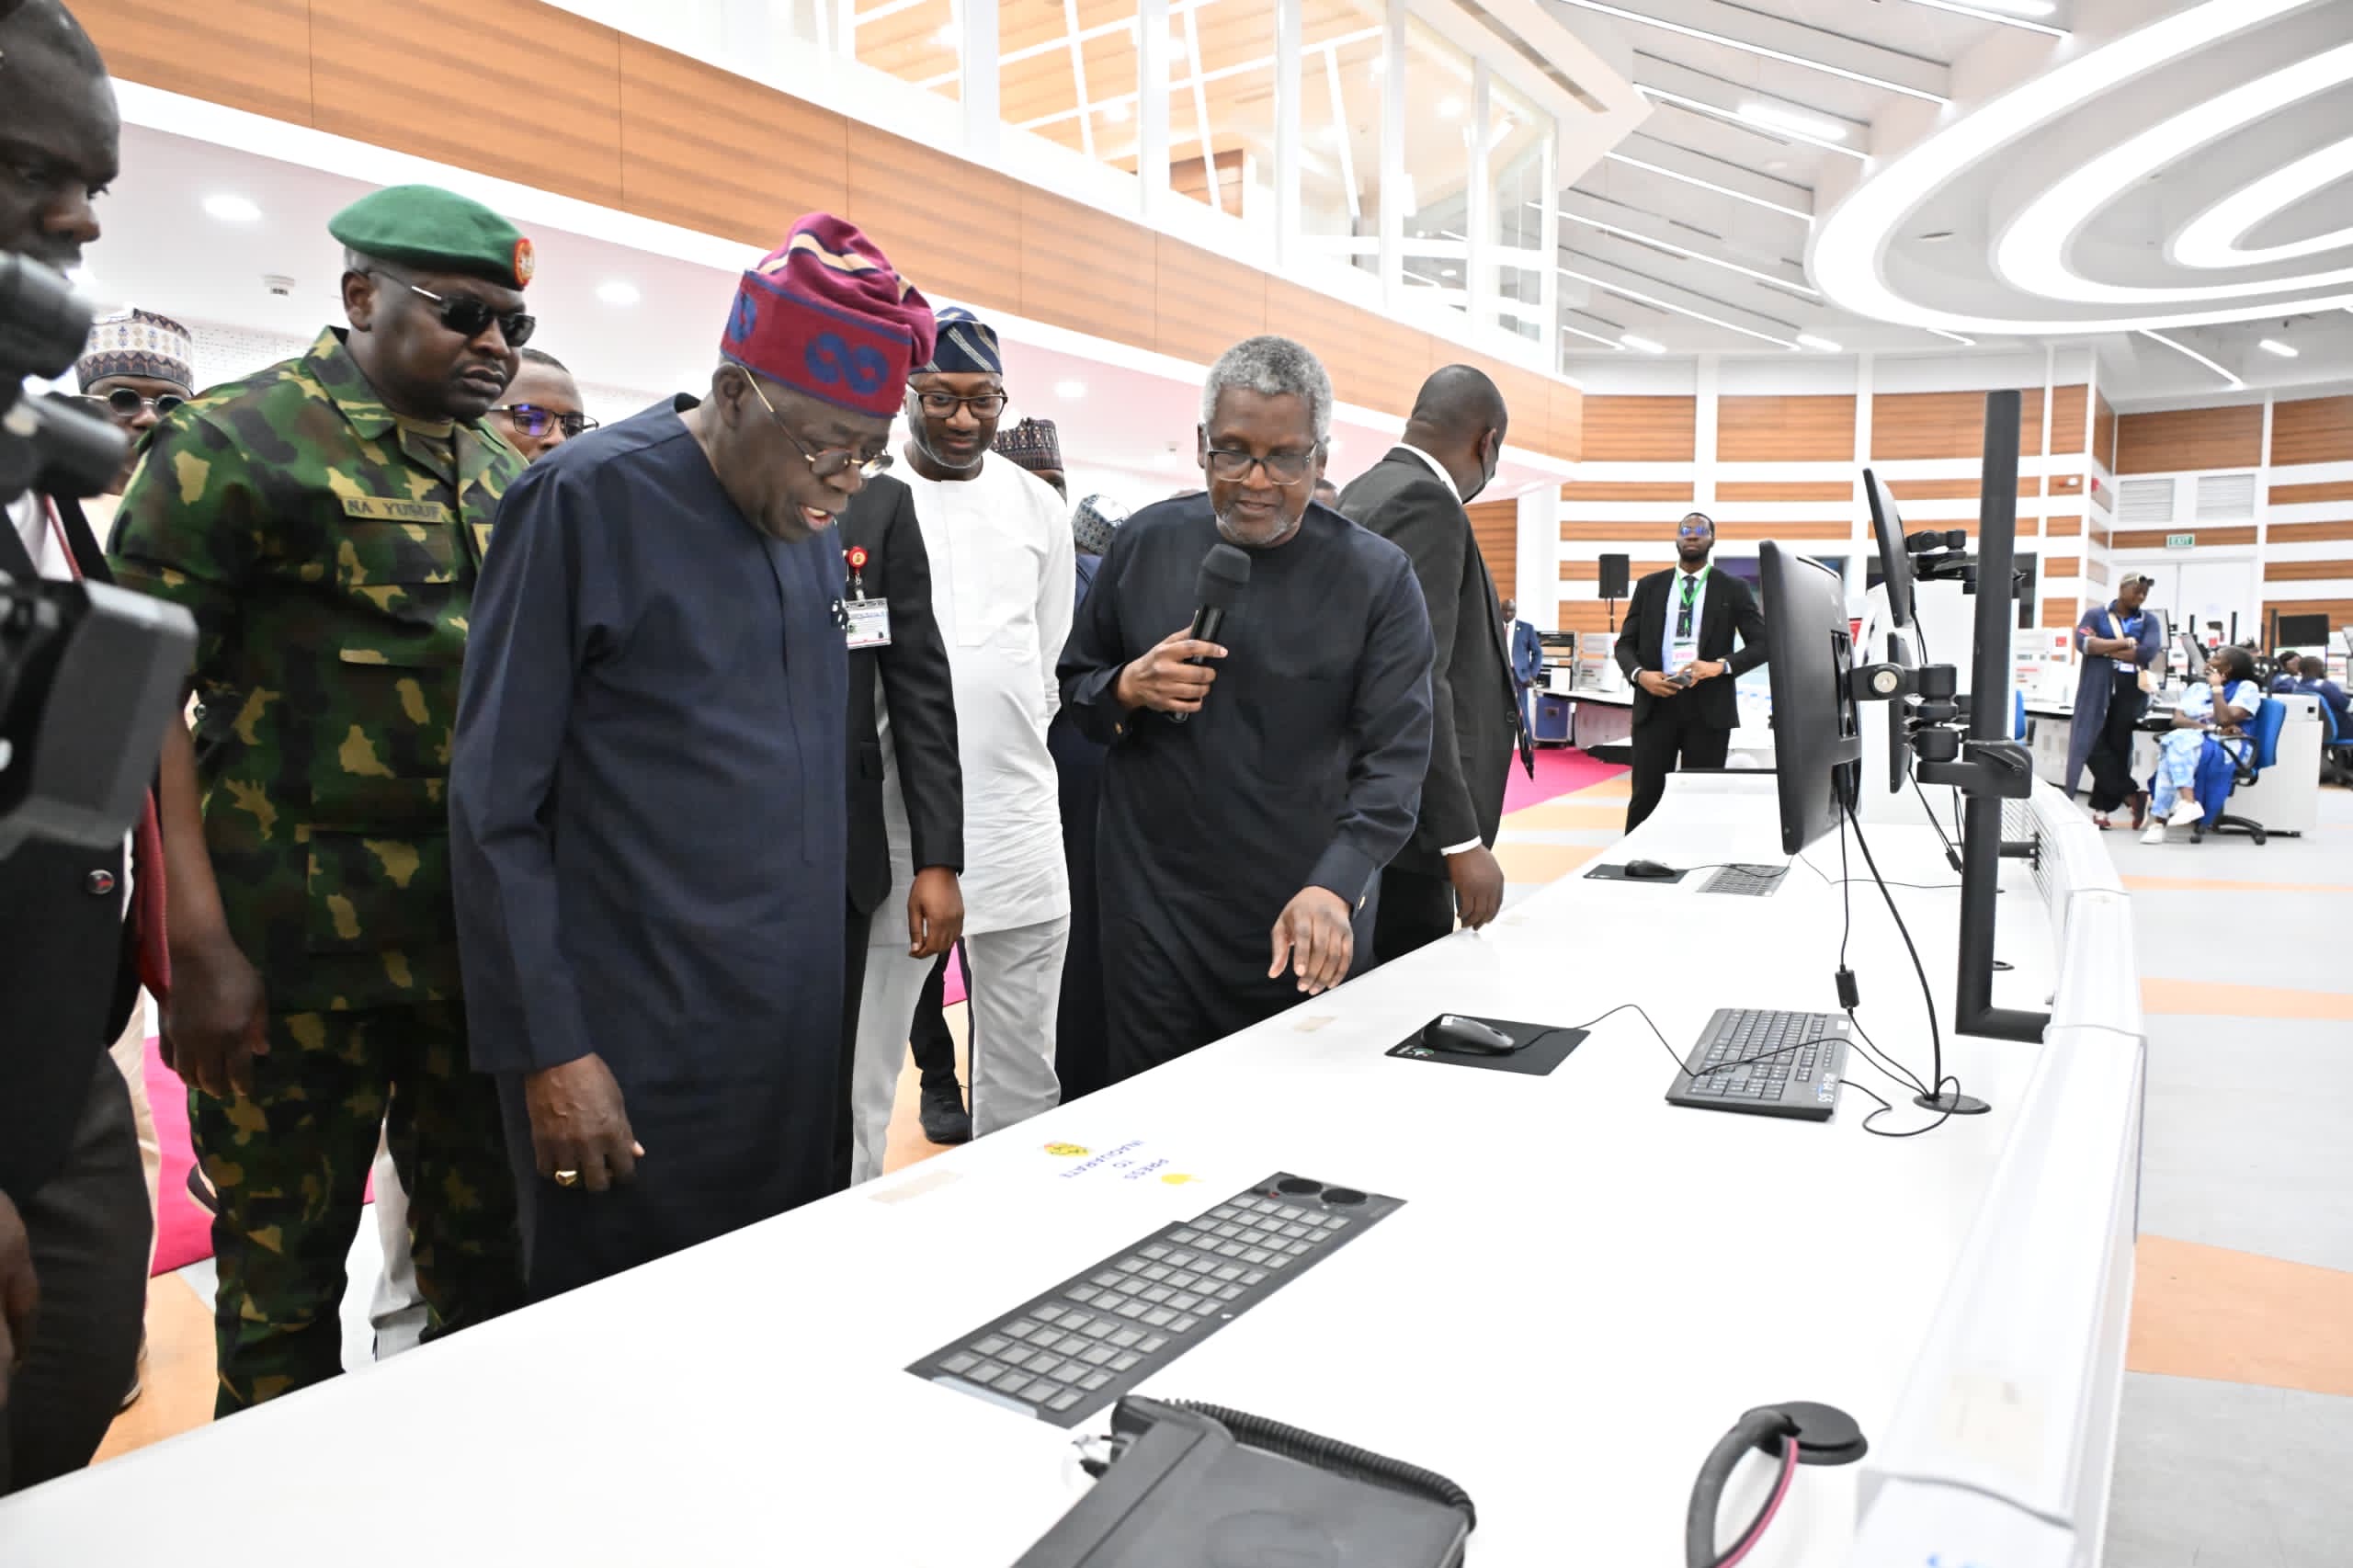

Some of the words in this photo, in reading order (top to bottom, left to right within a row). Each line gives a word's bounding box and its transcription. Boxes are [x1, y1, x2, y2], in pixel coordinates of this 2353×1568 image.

[383, 503, 439, 519] YUSUF
[2170, 536, 2189, 545] EXIT
[1112, 1160, 1135, 1168] TO
[1122, 1158, 1169, 1179] PRESS
